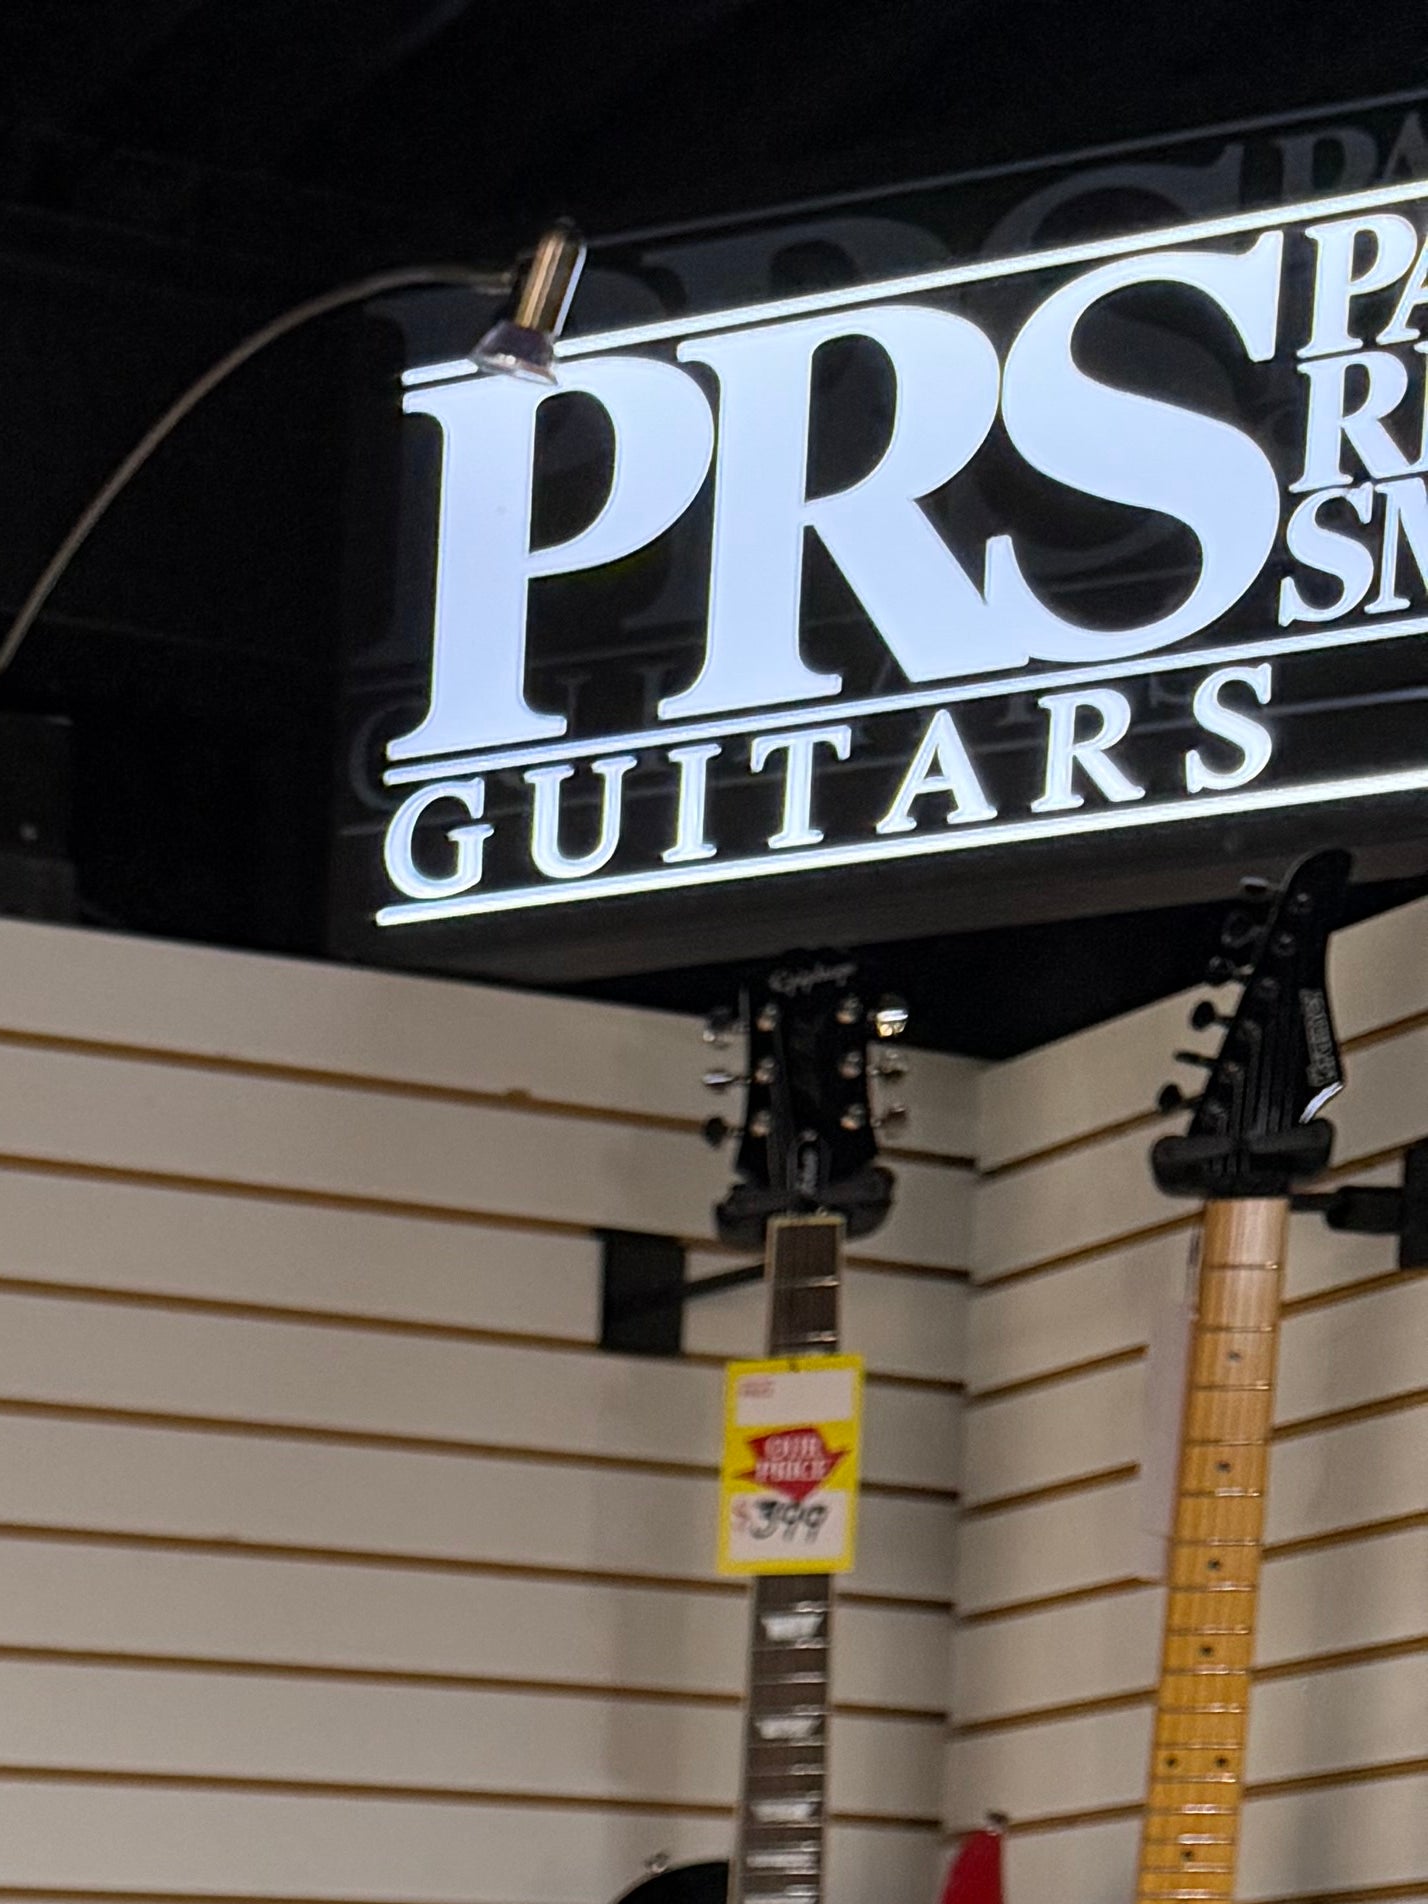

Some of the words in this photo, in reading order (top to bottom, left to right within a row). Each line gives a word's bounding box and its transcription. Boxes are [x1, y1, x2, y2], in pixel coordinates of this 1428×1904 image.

[387, 229, 1282, 763] PRS
[1289, 338, 1428, 493] R
[382, 662, 1274, 901] GUITARS
